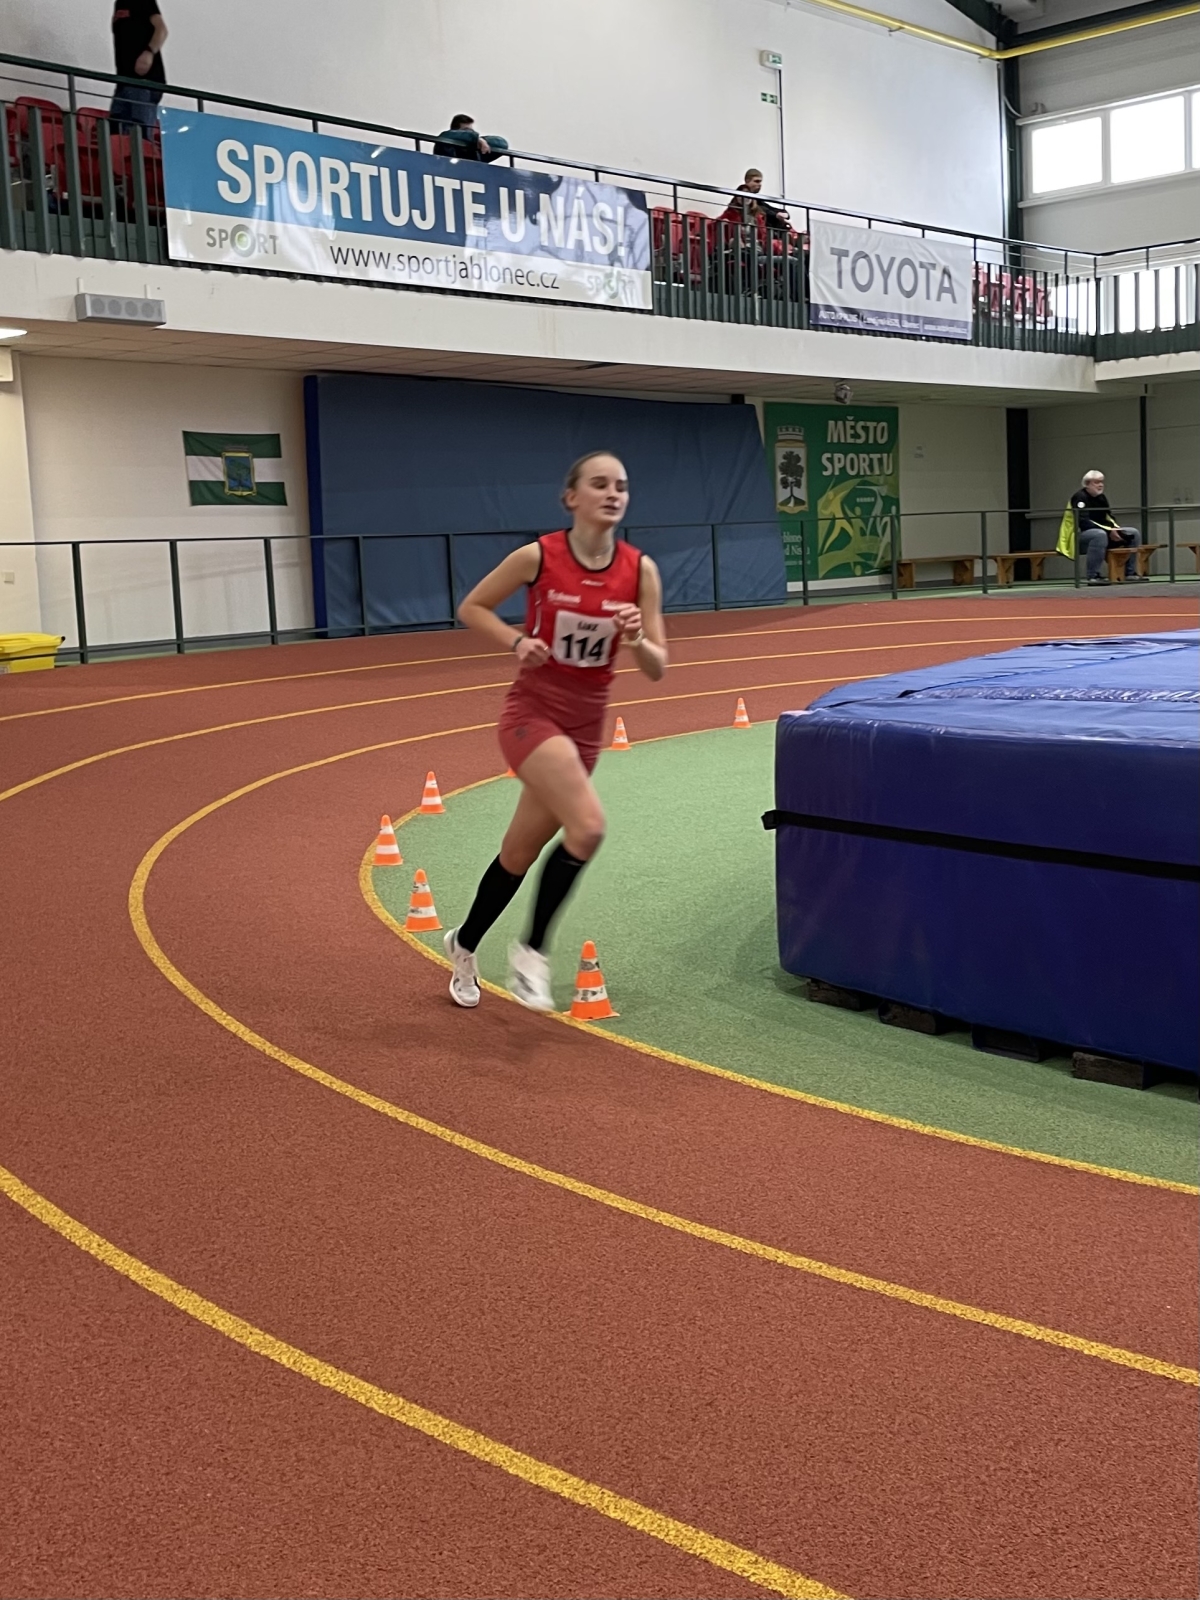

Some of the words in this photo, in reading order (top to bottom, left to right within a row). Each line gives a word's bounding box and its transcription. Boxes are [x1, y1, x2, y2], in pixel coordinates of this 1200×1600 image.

[217, 139, 488, 237] SPORTUJTE
[499, 187, 526, 243] U
[539, 186, 625, 257] NÁS!
[206, 224, 279, 258] SPORT
[330, 245, 560, 290] www.sportjablonec.cz
[830, 247, 957, 304] TOYOTA
[827, 416, 889, 445] MĚSTO
[821, 453, 893, 476] SPORTU
[561, 633, 608, 661] 114
